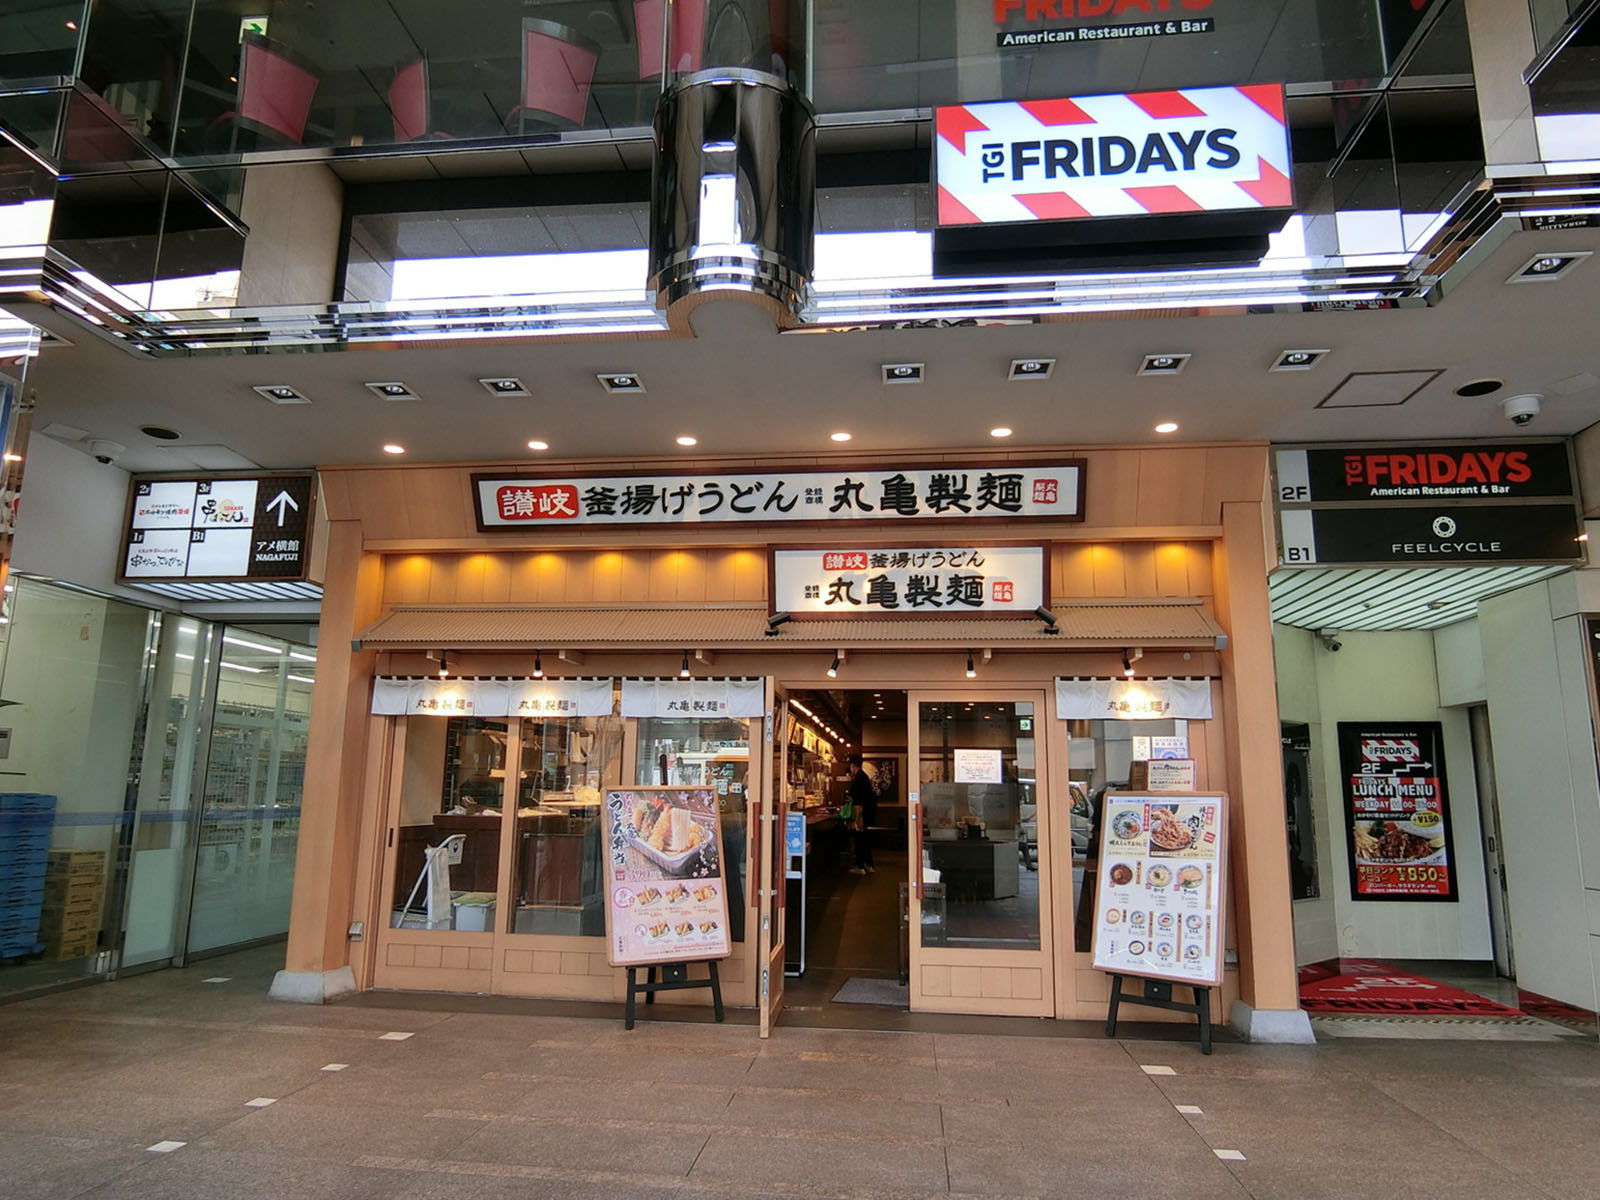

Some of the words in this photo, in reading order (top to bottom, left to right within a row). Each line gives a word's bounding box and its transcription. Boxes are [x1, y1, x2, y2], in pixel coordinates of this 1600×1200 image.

[1002, 30, 1074, 46] American
[1079, 24, 1160, 40] Restaurant
[1165, 22, 1176, 33] &
[1181, 20, 1208, 32] Bar
[982, 143, 1004, 183] TGI
[1011, 128, 1241, 181] FRIDAYS
[1344, 456, 1362, 486] TGI
[1366, 452, 1532, 485] FRIDAYS
[139, 484, 150, 494] 2F
[580, 481, 798, 515] 釜揚げうどん
[829, 472, 1025, 516] 丸亀製麺
[1282, 487, 1308, 500] 2F
[1370, 486, 1420, 496] American
[1422, 485, 1478, 496] Restaurant
[1481, 485, 1489, 494] &
[1492, 485, 1510, 494] Bar
[192, 531, 204, 540] B1
[256, 540, 300, 551] アメ横館
[1392, 542, 1502, 553] FEELCYCLE
[869, 551, 986, 569] 釜揚げうどん
[1288, 548, 1310, 561] B1
[824, 574, 984, 608] 丸亀製麺
[667, 700, 718, 712] 丸亀製麺
[1106, 700, 1163, 712] 丸亀麺
[1374, 746, 1412, 754] FRIDAYS
[1362, 763, 1380, 773] 2F
[1353, 784, 1394, 796] LUNCH
[1399, 784, 1434, 796] MENU
